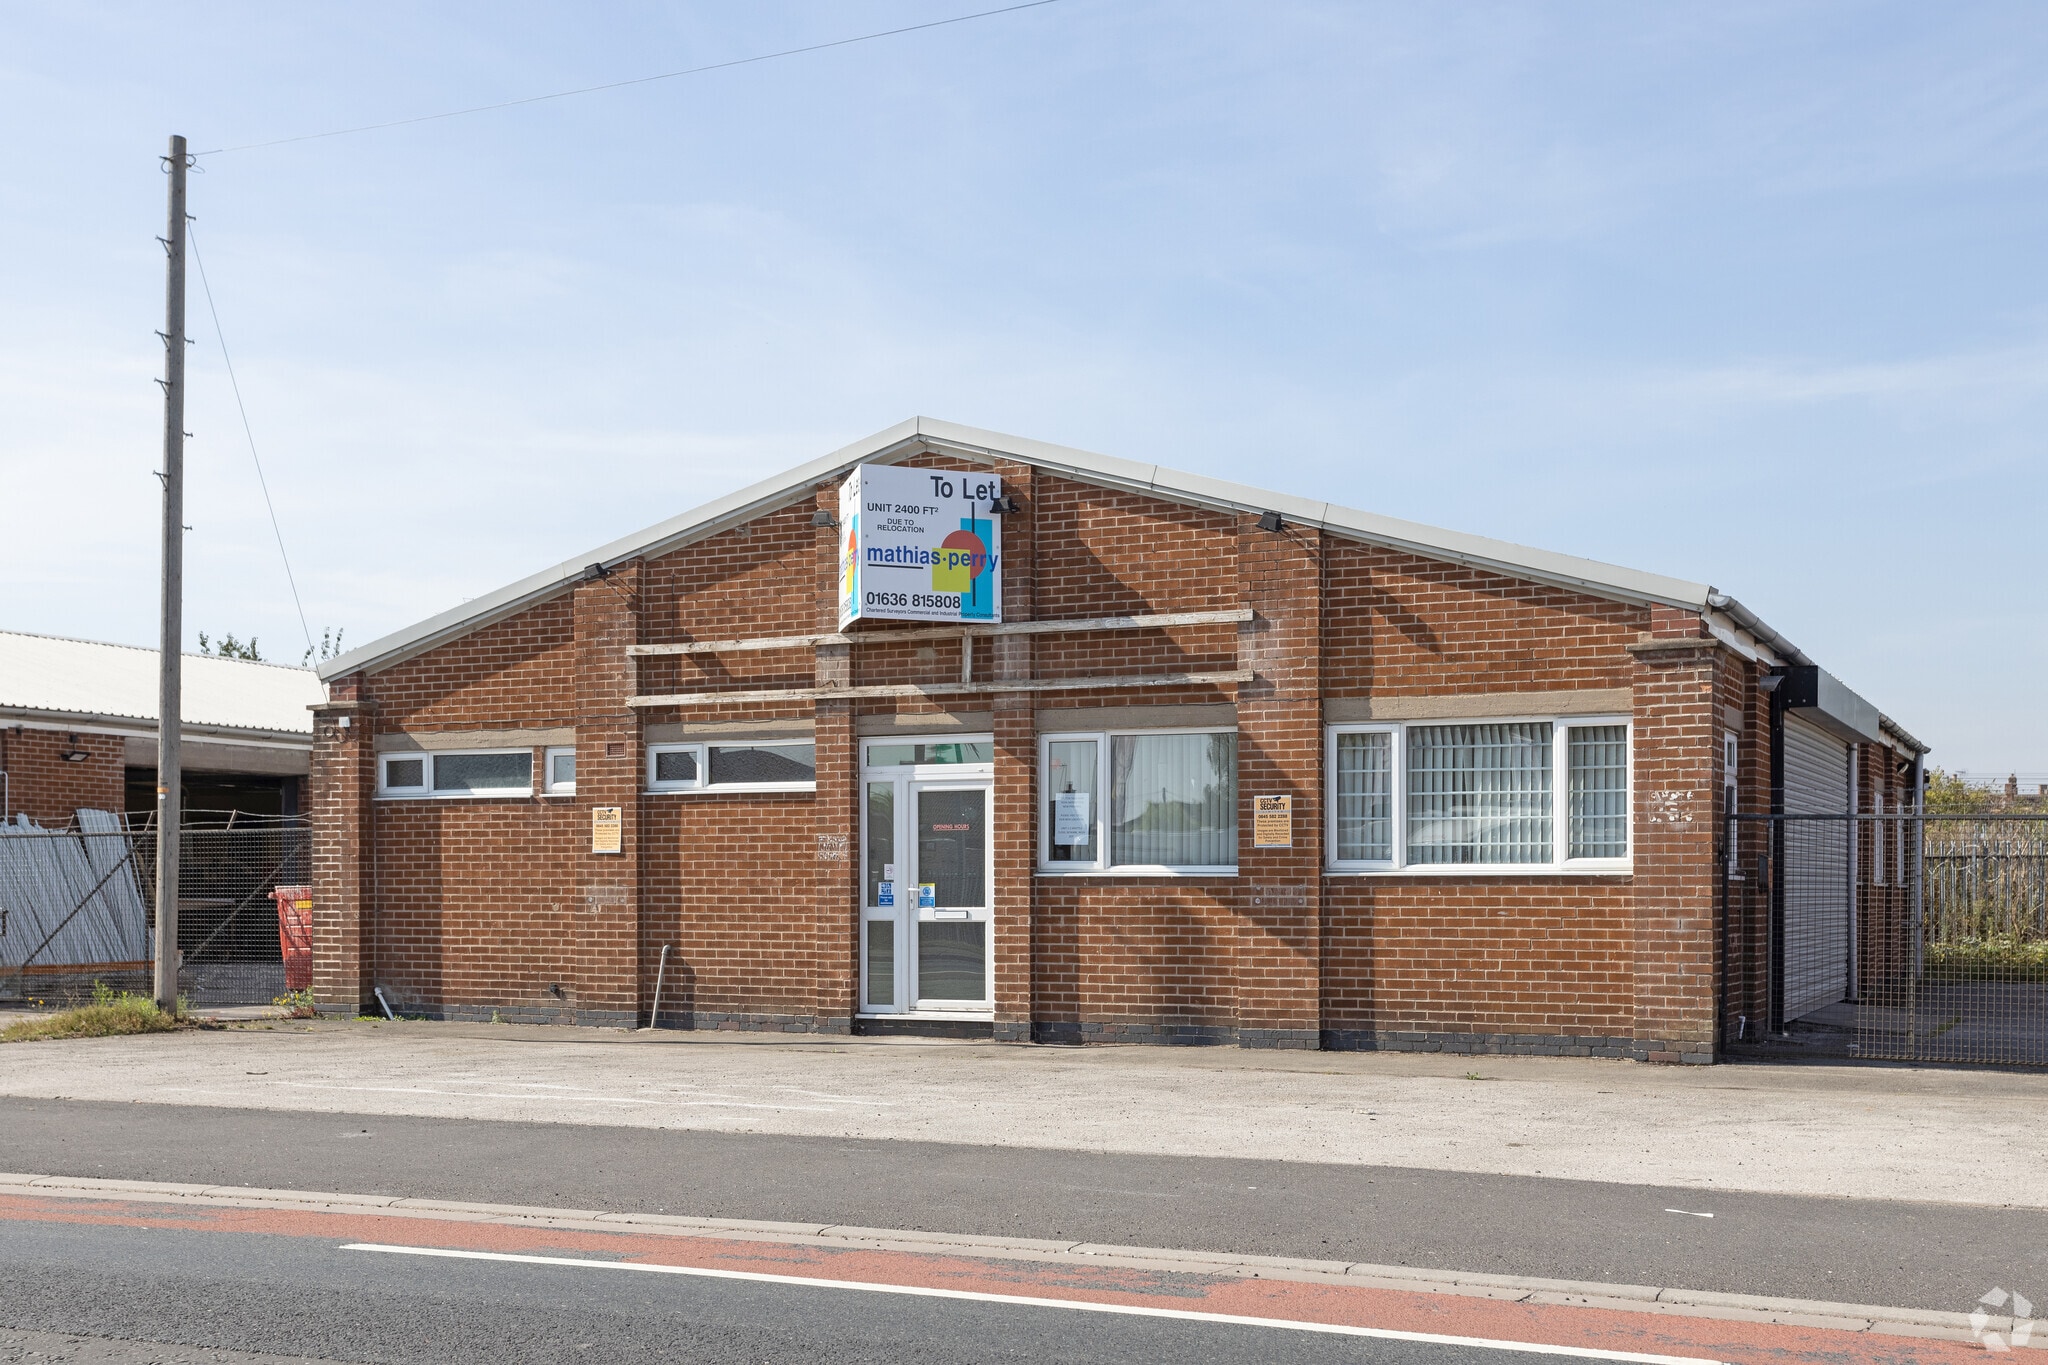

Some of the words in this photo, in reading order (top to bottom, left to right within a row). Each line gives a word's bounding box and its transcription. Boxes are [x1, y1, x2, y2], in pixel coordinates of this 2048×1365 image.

[930, 476, 953, 498] To
[963, 478, 996, 500] Let
[867, 502, 892, 512] UNIT
[895, 504, 920, 514] 2400
[877, 524, 924, 533] RELOCATION
[866, 592, 908, 606] 01636
[912, 594, 961, 609] 815808
